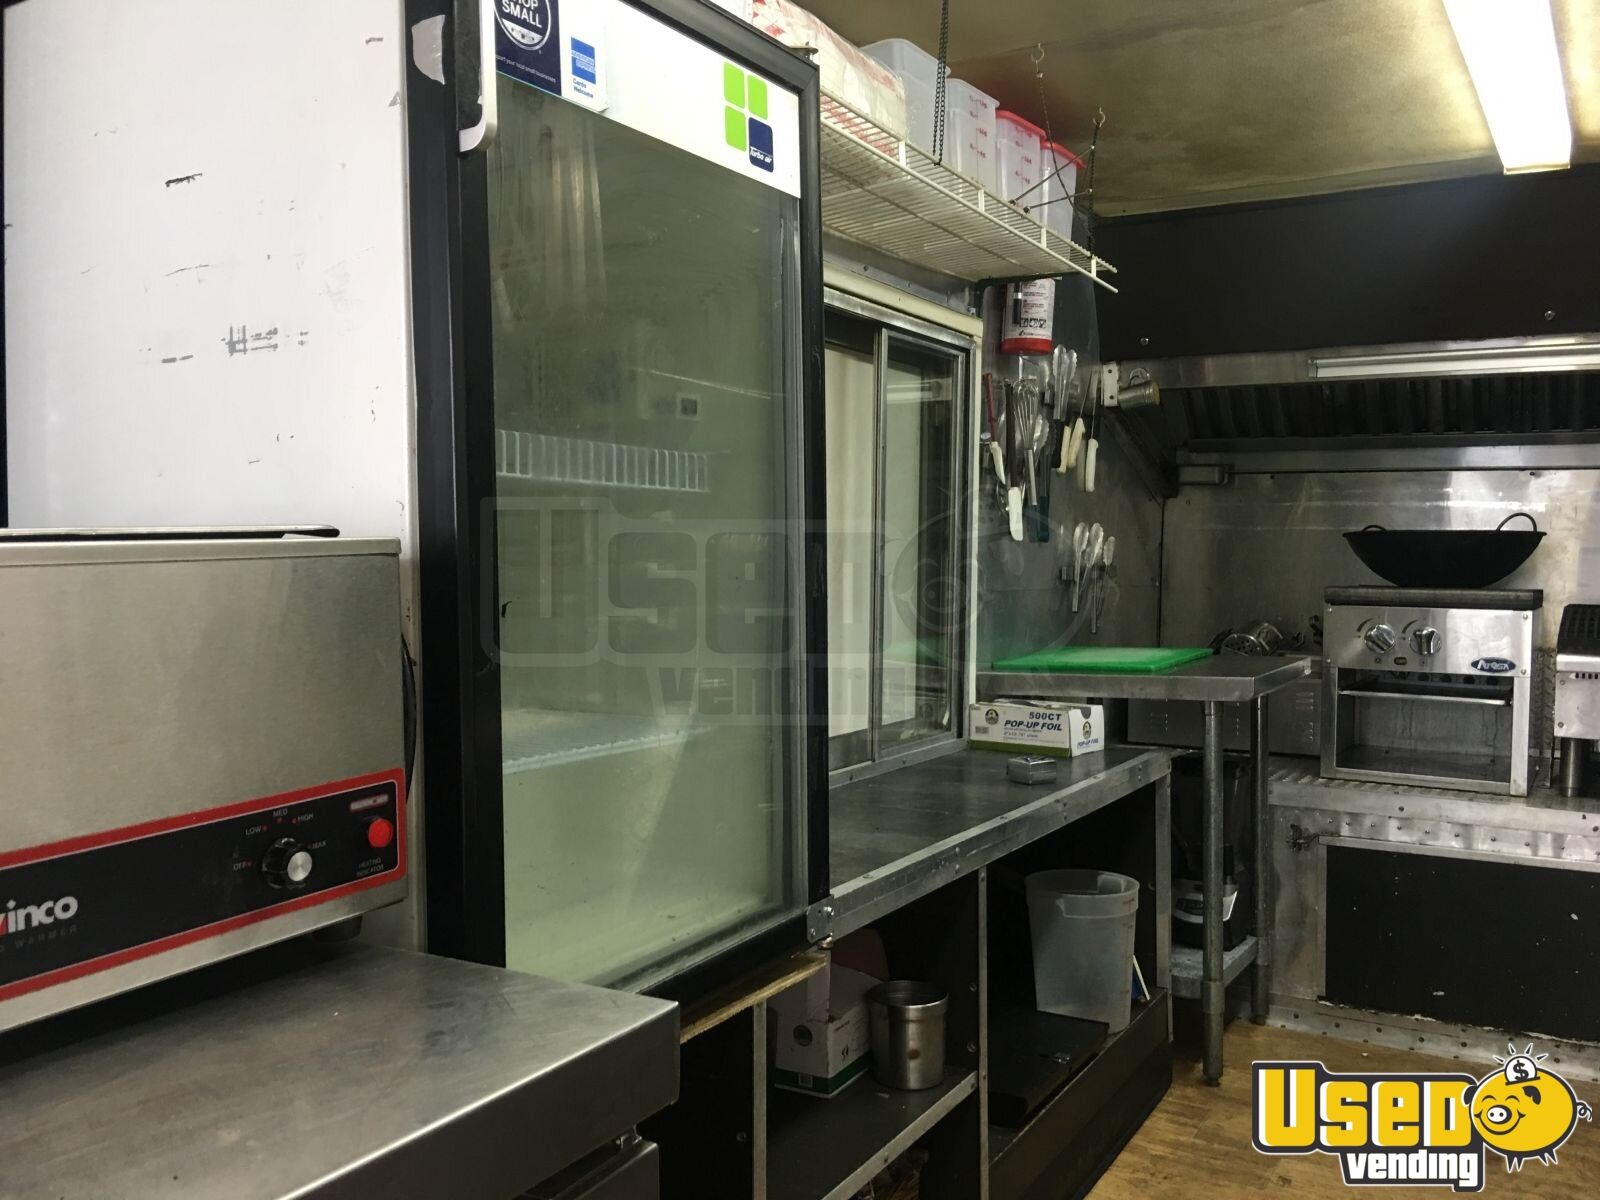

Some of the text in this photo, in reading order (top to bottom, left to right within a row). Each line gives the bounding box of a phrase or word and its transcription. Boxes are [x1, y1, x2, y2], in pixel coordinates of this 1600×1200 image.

[502, 0, 542, 28] SMALL
[1029, 711, 1062, 721] 500CT
[1004, 720, 1039, 730] POP-UP
[1040, 723, 1063, 732] FOIL
[273, 808, 288, 817] MED
[298, 812, 314, 823] HIGH
[245, 826, 262, 835] LOW
[312, 840, 327, 850] MAX
[233, 862, 248, 871] OFF
